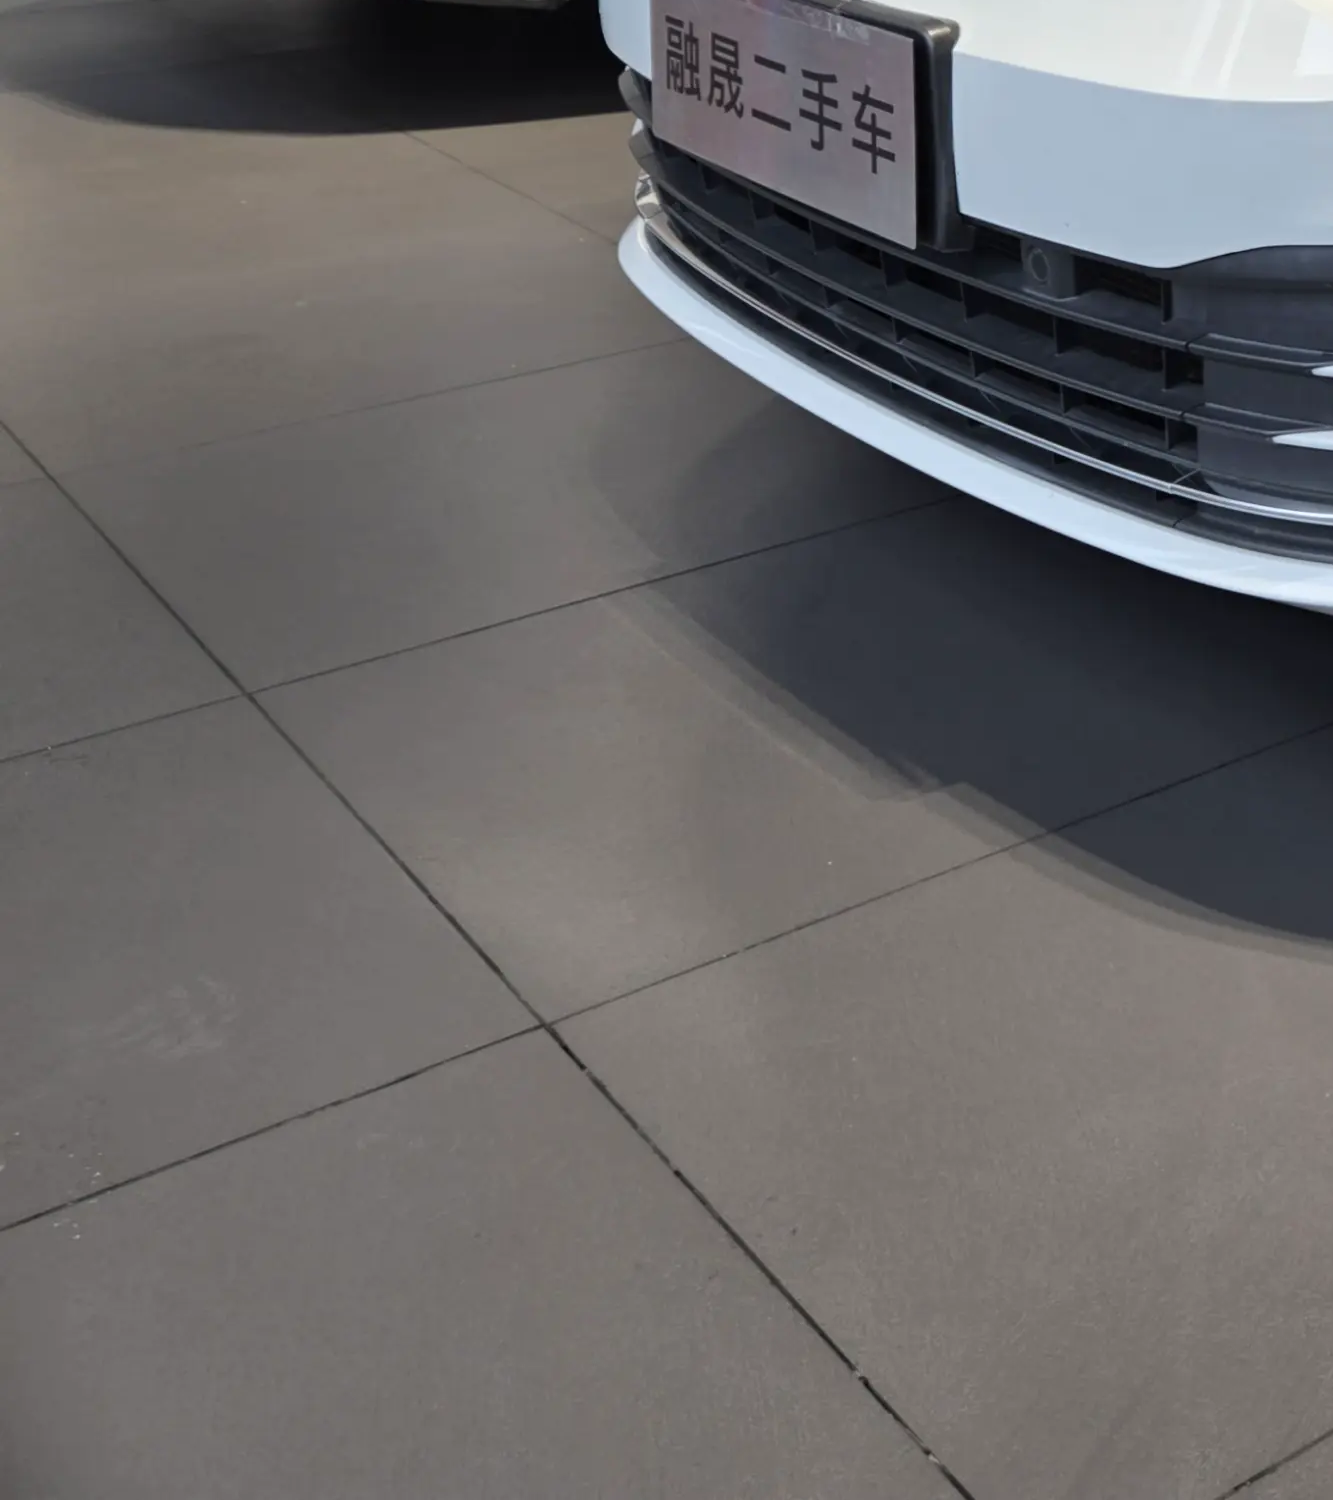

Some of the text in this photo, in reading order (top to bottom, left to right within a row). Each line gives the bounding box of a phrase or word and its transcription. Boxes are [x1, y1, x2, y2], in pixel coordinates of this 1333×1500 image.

[665, 14, 897, 174] 融晟二手车
